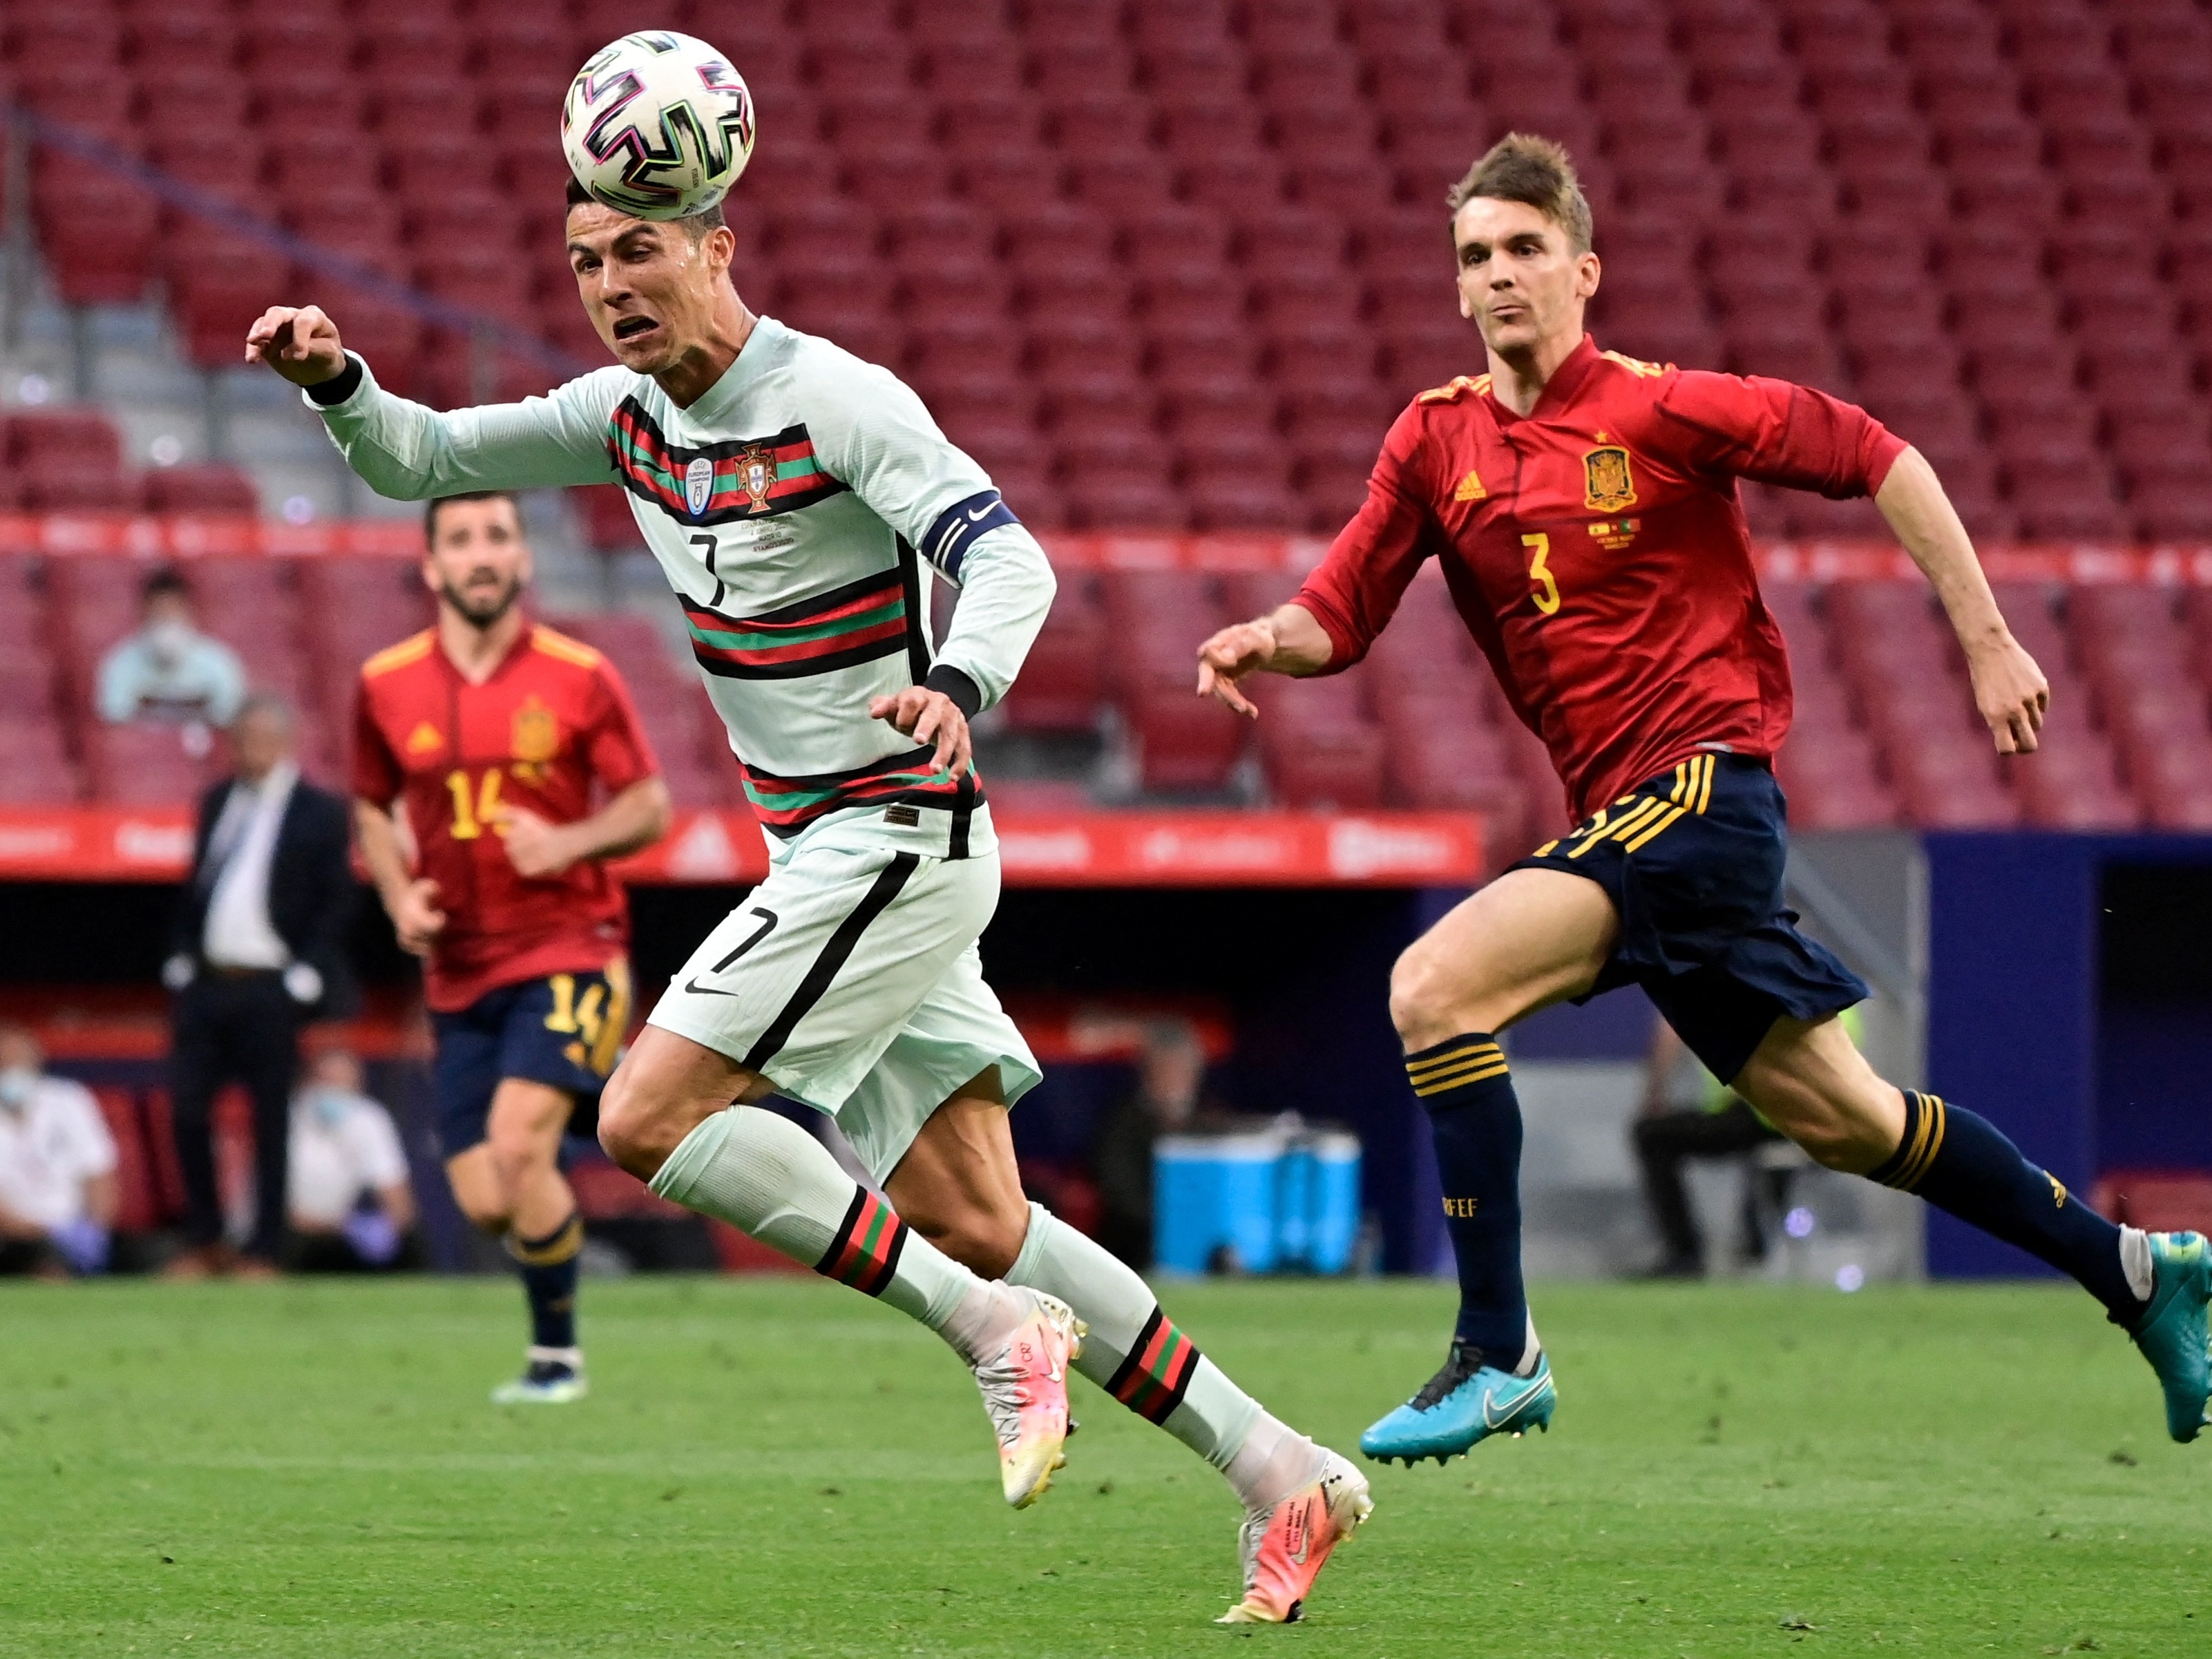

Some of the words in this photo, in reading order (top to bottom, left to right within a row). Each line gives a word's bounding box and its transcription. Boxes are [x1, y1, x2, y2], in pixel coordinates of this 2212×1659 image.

[689, 534, 725, 607] 7
[1521, 532, 1560, 614] 3
[709, 907, 777, 974] 7
[543, 974, 604, 1045] 14
[1020, 1343, 1033, 1362] CR7
